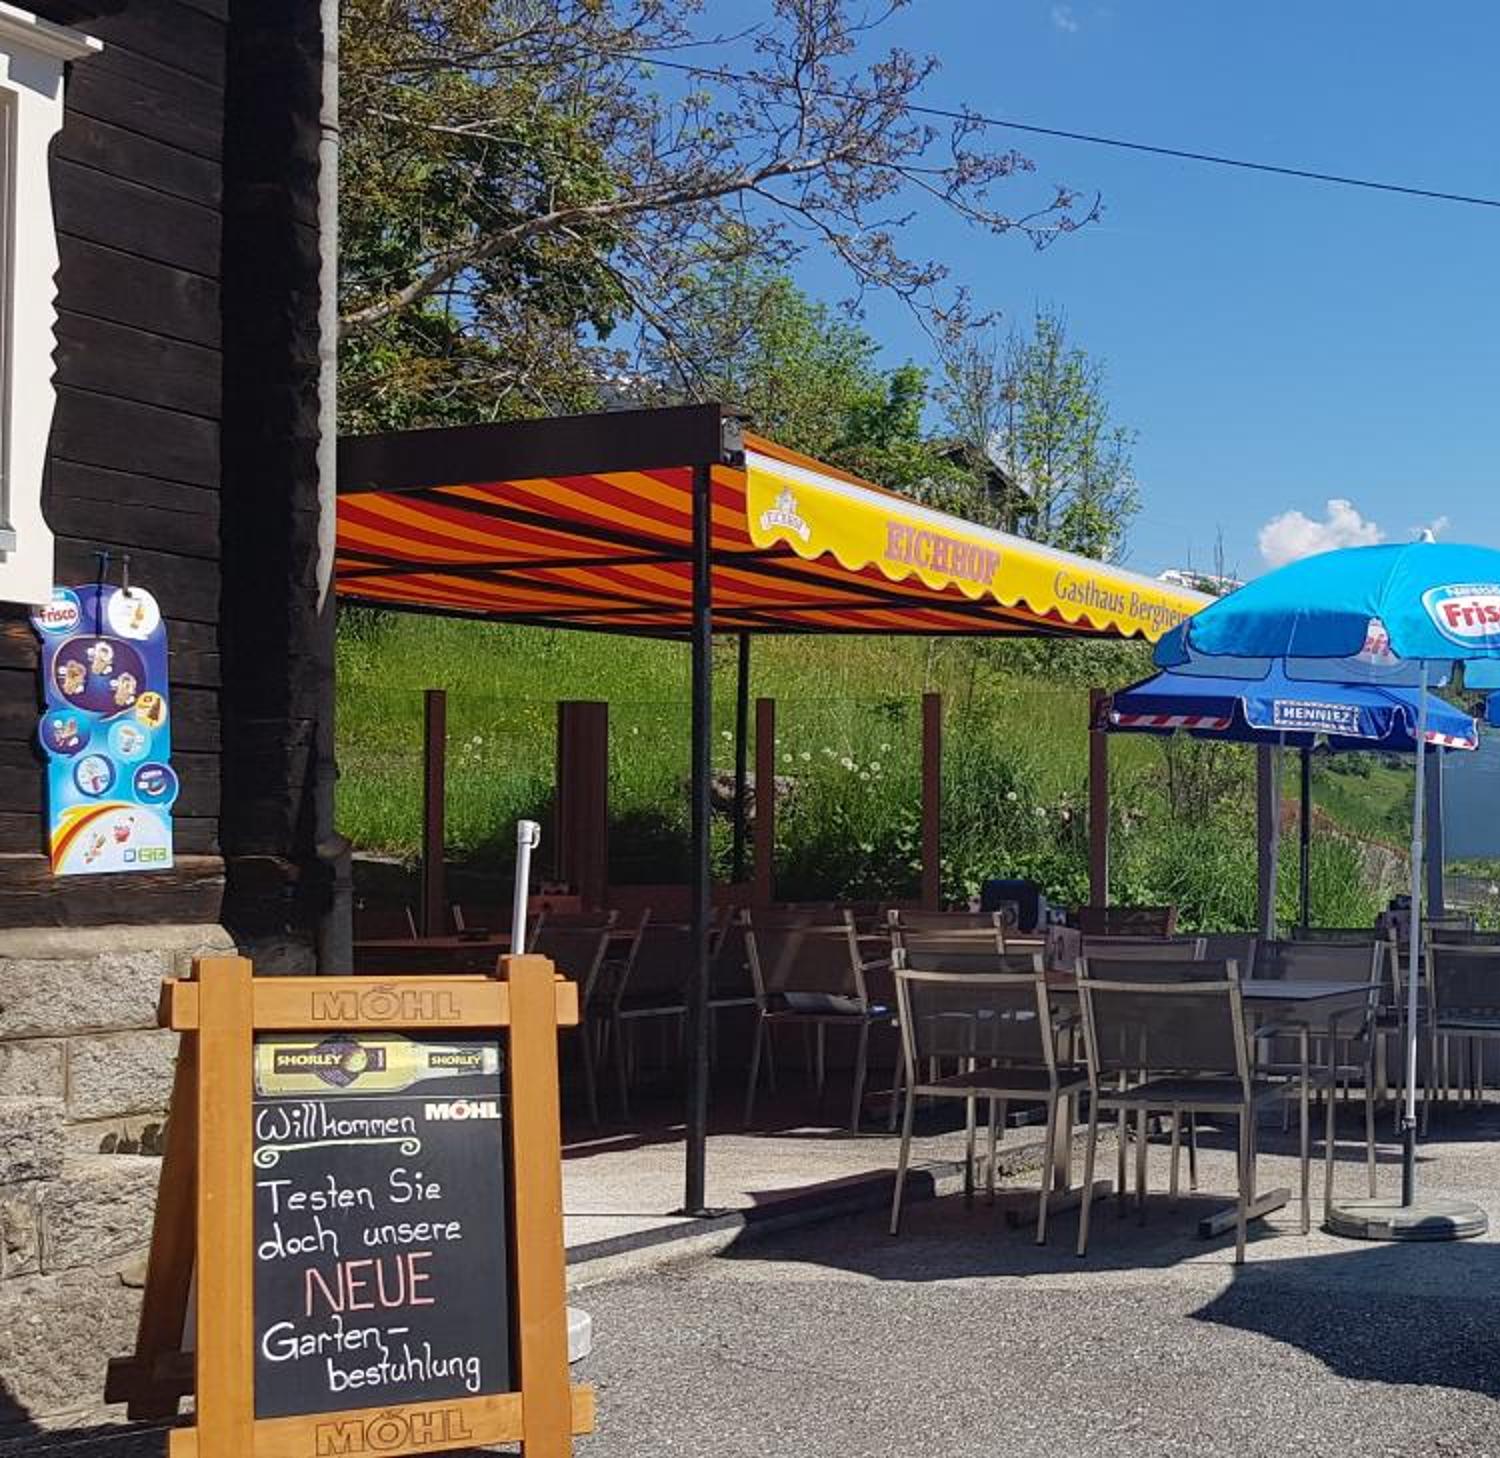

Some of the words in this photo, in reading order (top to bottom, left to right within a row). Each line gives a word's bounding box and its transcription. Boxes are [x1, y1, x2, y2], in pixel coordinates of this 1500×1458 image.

[885, 521, 1000, 584] EICHHOF
[39, 607, 77, 622] Frisco
[1054, 571, 1125, 614] Gasthaus
[1130, 591, 1189, 632] Berghei
[1283, 706, 1351, 722] HENNIEZ
[312, 982, 461, 1021] MÖHL
[277, 1052, 343, 1067] SHORLEY
[430, 1053, 481, 1067] SHORLEY
[256, 1101, 417, 1140] Willkommen
[425, 1099, 502, 1121] MÖHL
[256, 1174, 375, 1214] Testen
[389, 1167, 442, 1203] Sie
[257, 1215, 340, 1260] doch
[363, 1219, 463, 1247] unsere
[304, 1251, 436, 1317] NEUE
[261, 1314, 410, 1362] Garten-
[326, 1341, 482, 1392] bestuhlung
[315, 1408, 473, 1457] MÖHL
